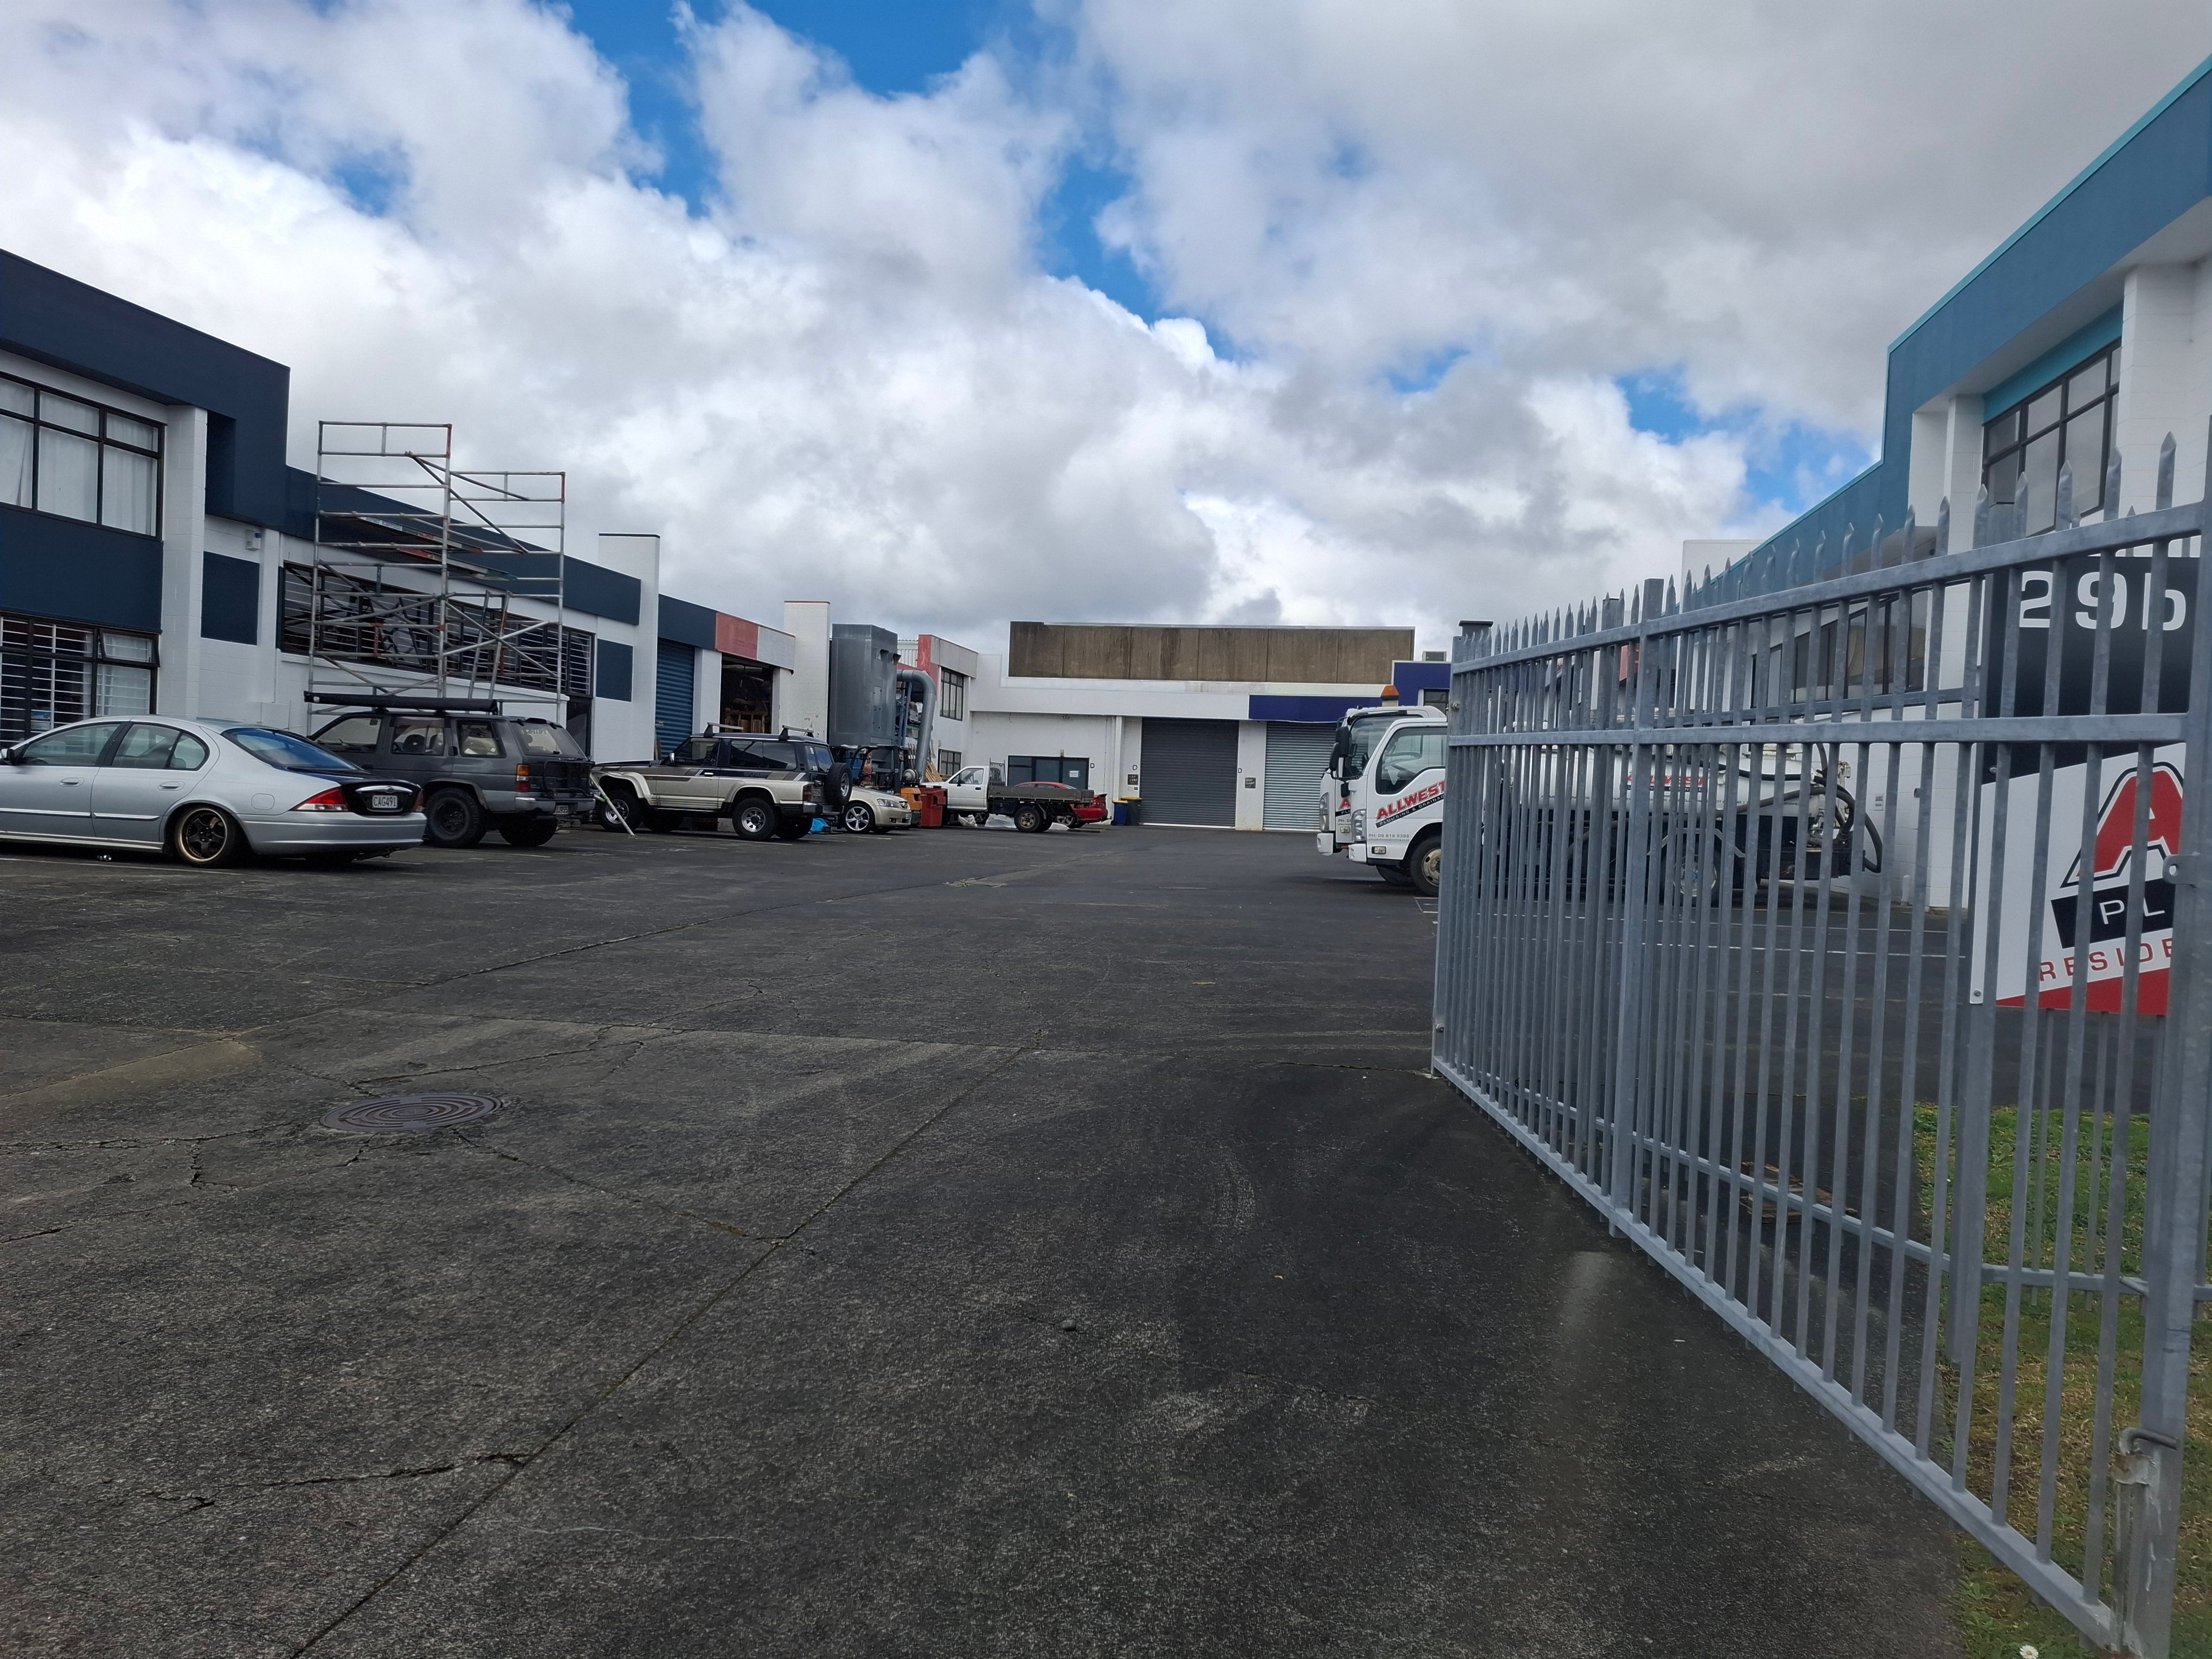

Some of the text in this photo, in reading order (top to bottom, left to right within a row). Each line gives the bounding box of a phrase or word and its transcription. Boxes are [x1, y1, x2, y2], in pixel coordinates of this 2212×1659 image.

[374, 796, 396, 807] CAG491
[1375, 780, 1445, 822] ALLWEST
[1379, 810, 1410, 826] PLUMBING
